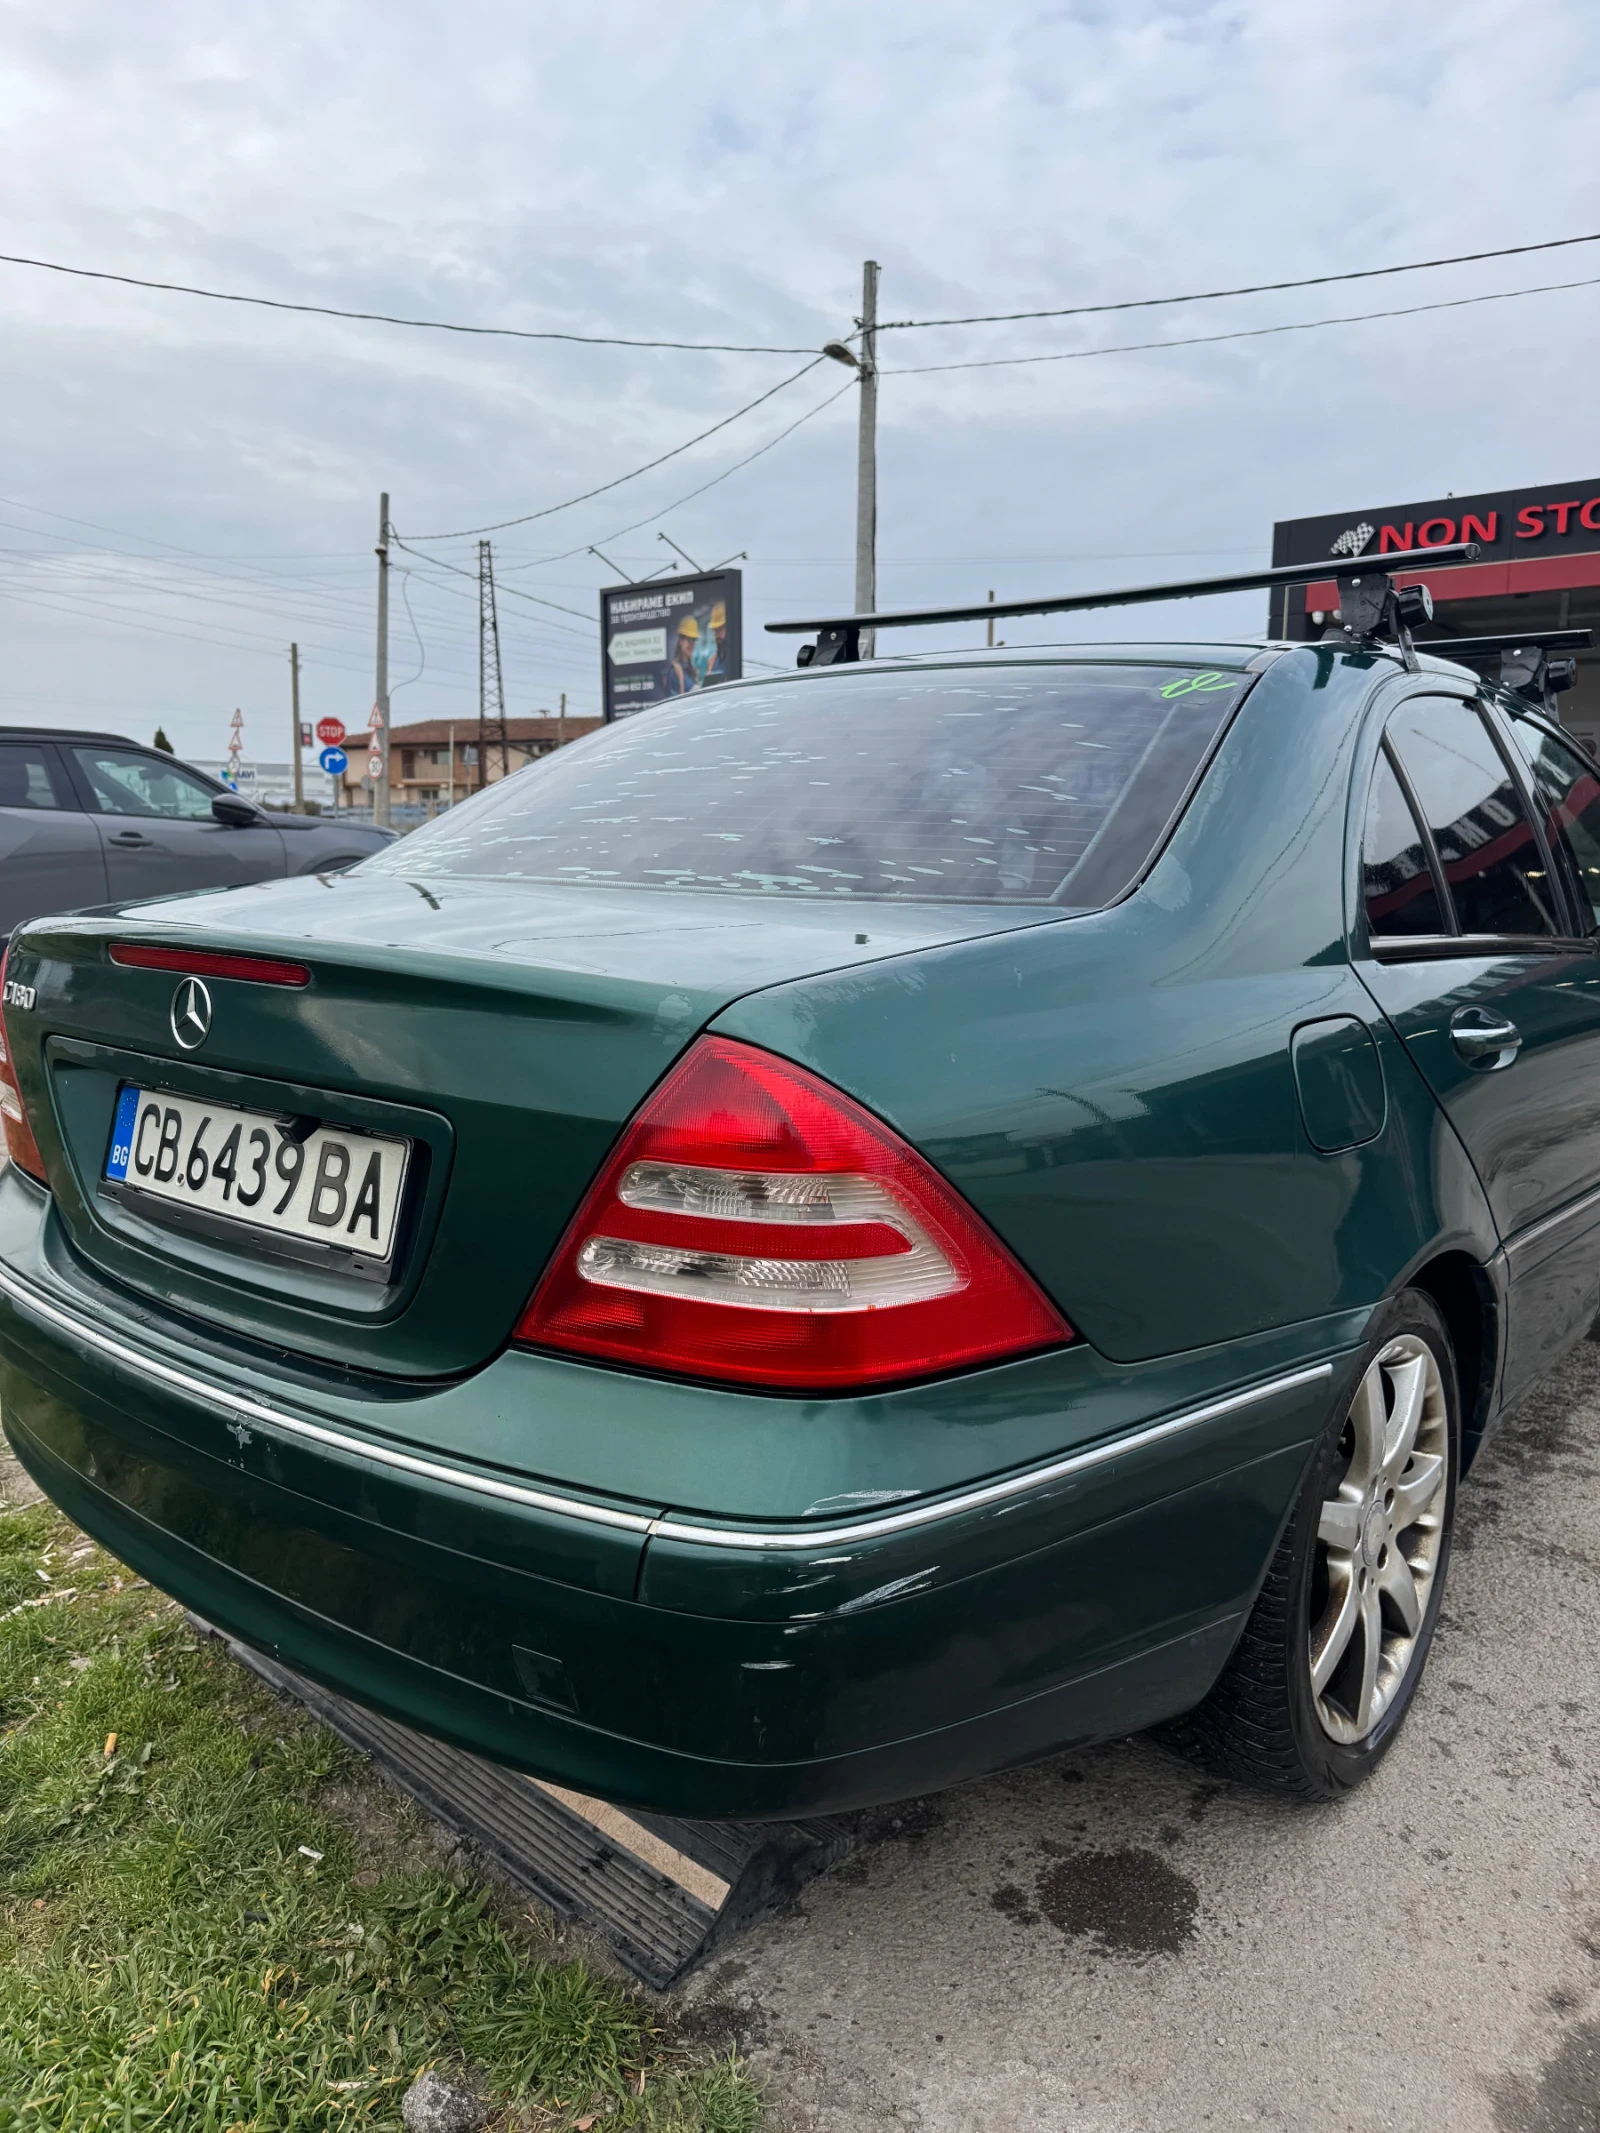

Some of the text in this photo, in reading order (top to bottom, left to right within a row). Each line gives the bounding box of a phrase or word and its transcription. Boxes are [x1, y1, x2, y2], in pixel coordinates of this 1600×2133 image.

[1380, 511, 1497, 553] NON
[610, 591, 694, 614] НАБИРАМЕ ЕКИП
[319, 725, 343, 738] STOP
[371, 760, 381, 772] 30
[112, 1145, 130, 1167] BG
